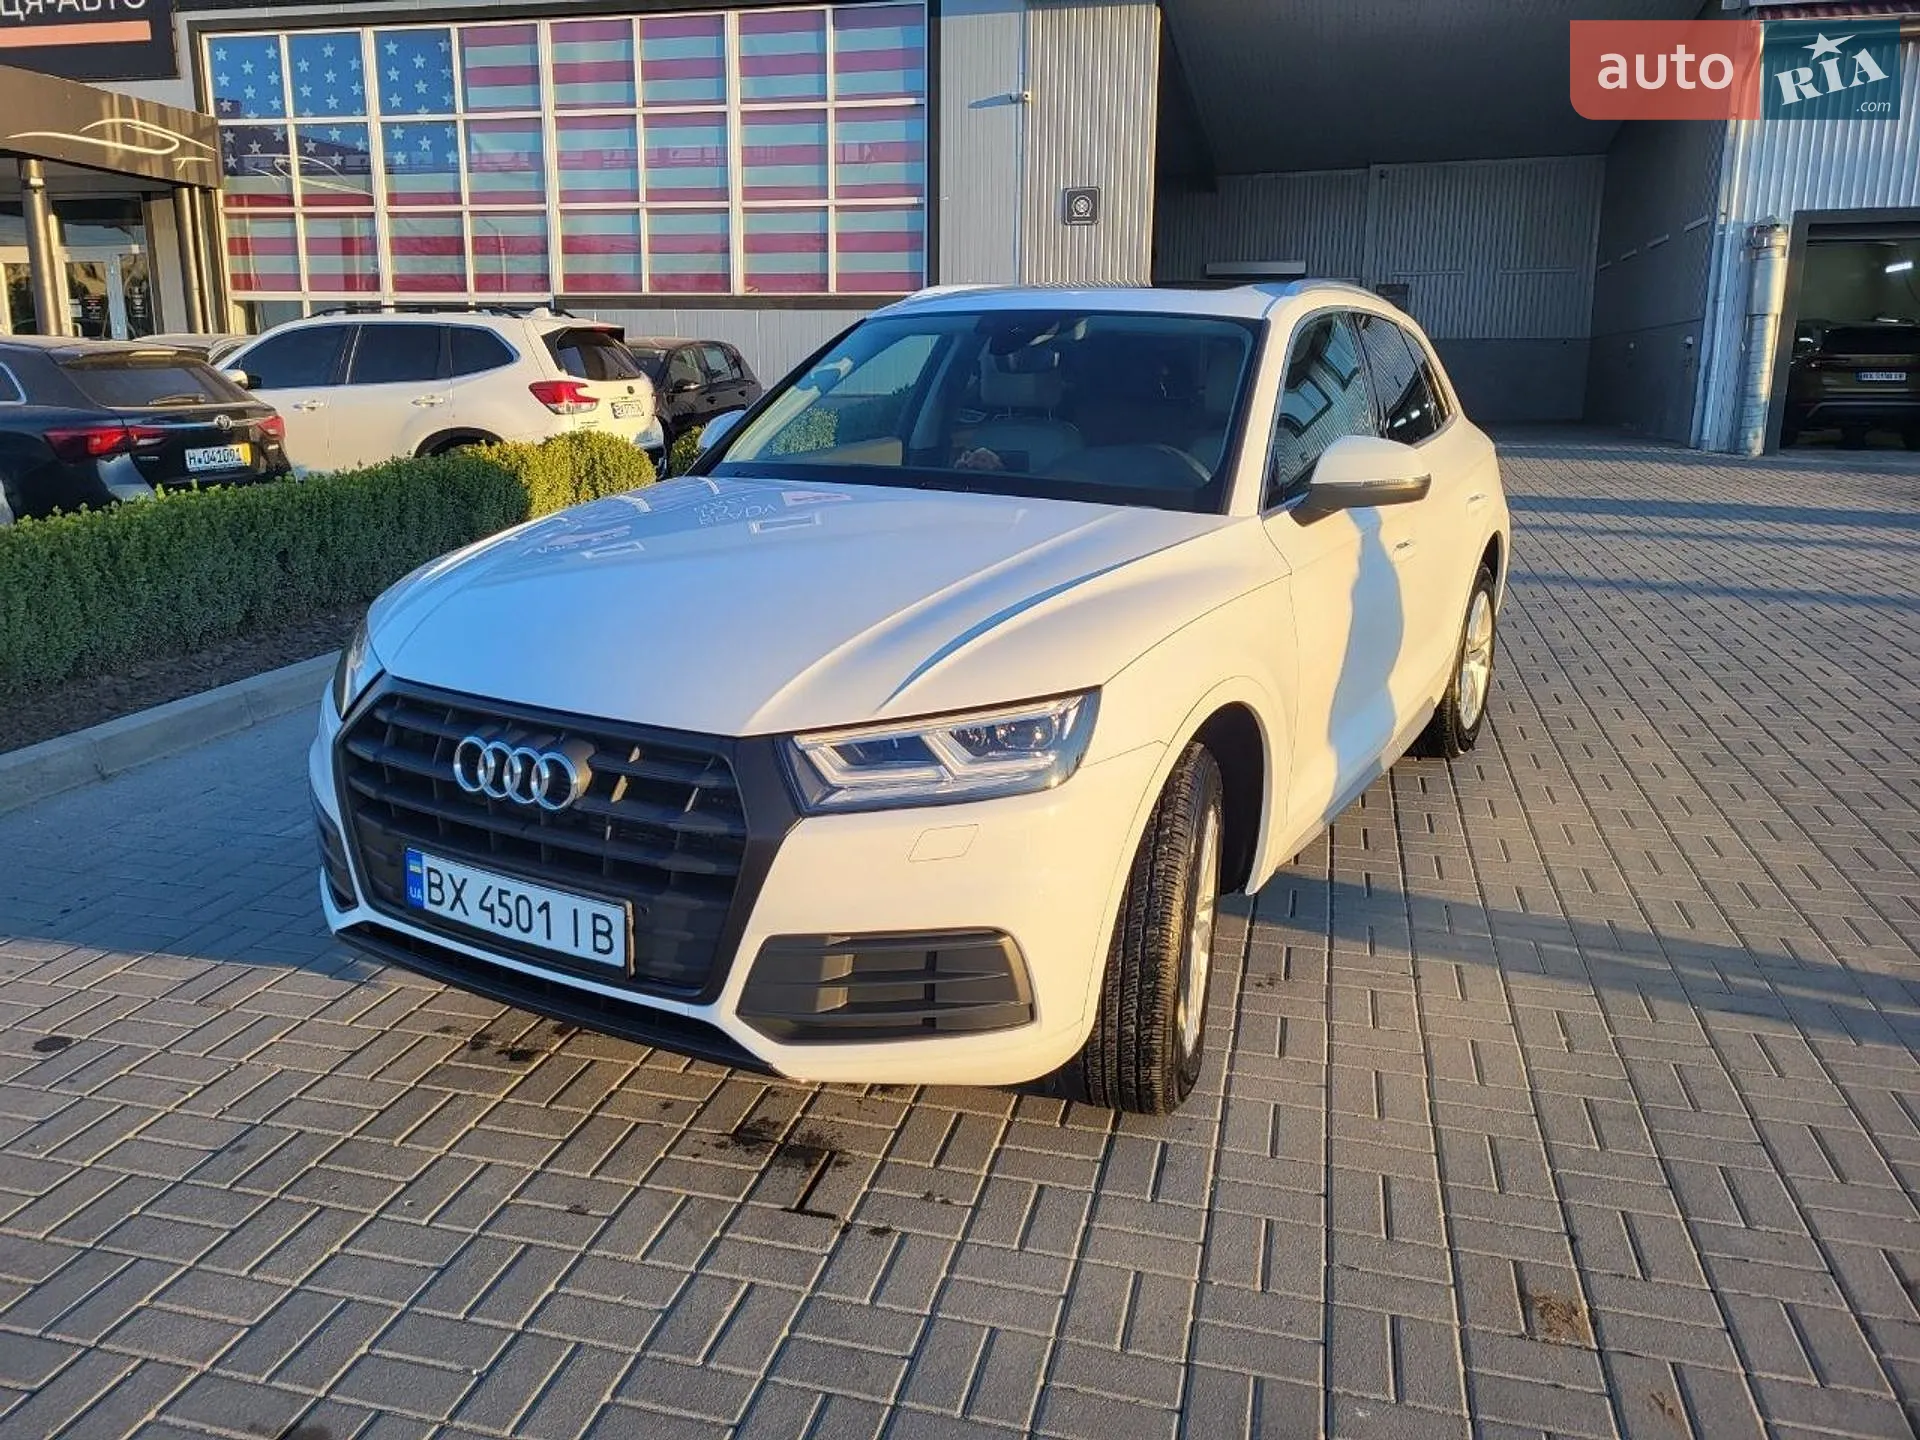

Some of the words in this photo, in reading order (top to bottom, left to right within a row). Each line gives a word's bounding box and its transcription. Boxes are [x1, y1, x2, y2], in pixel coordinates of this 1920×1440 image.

[409, 886, 423, 901] UA
[426, 866, 469, 917] BX
[478, 885, 552, 941] 4501
[572, 908, 614, 955] IB
